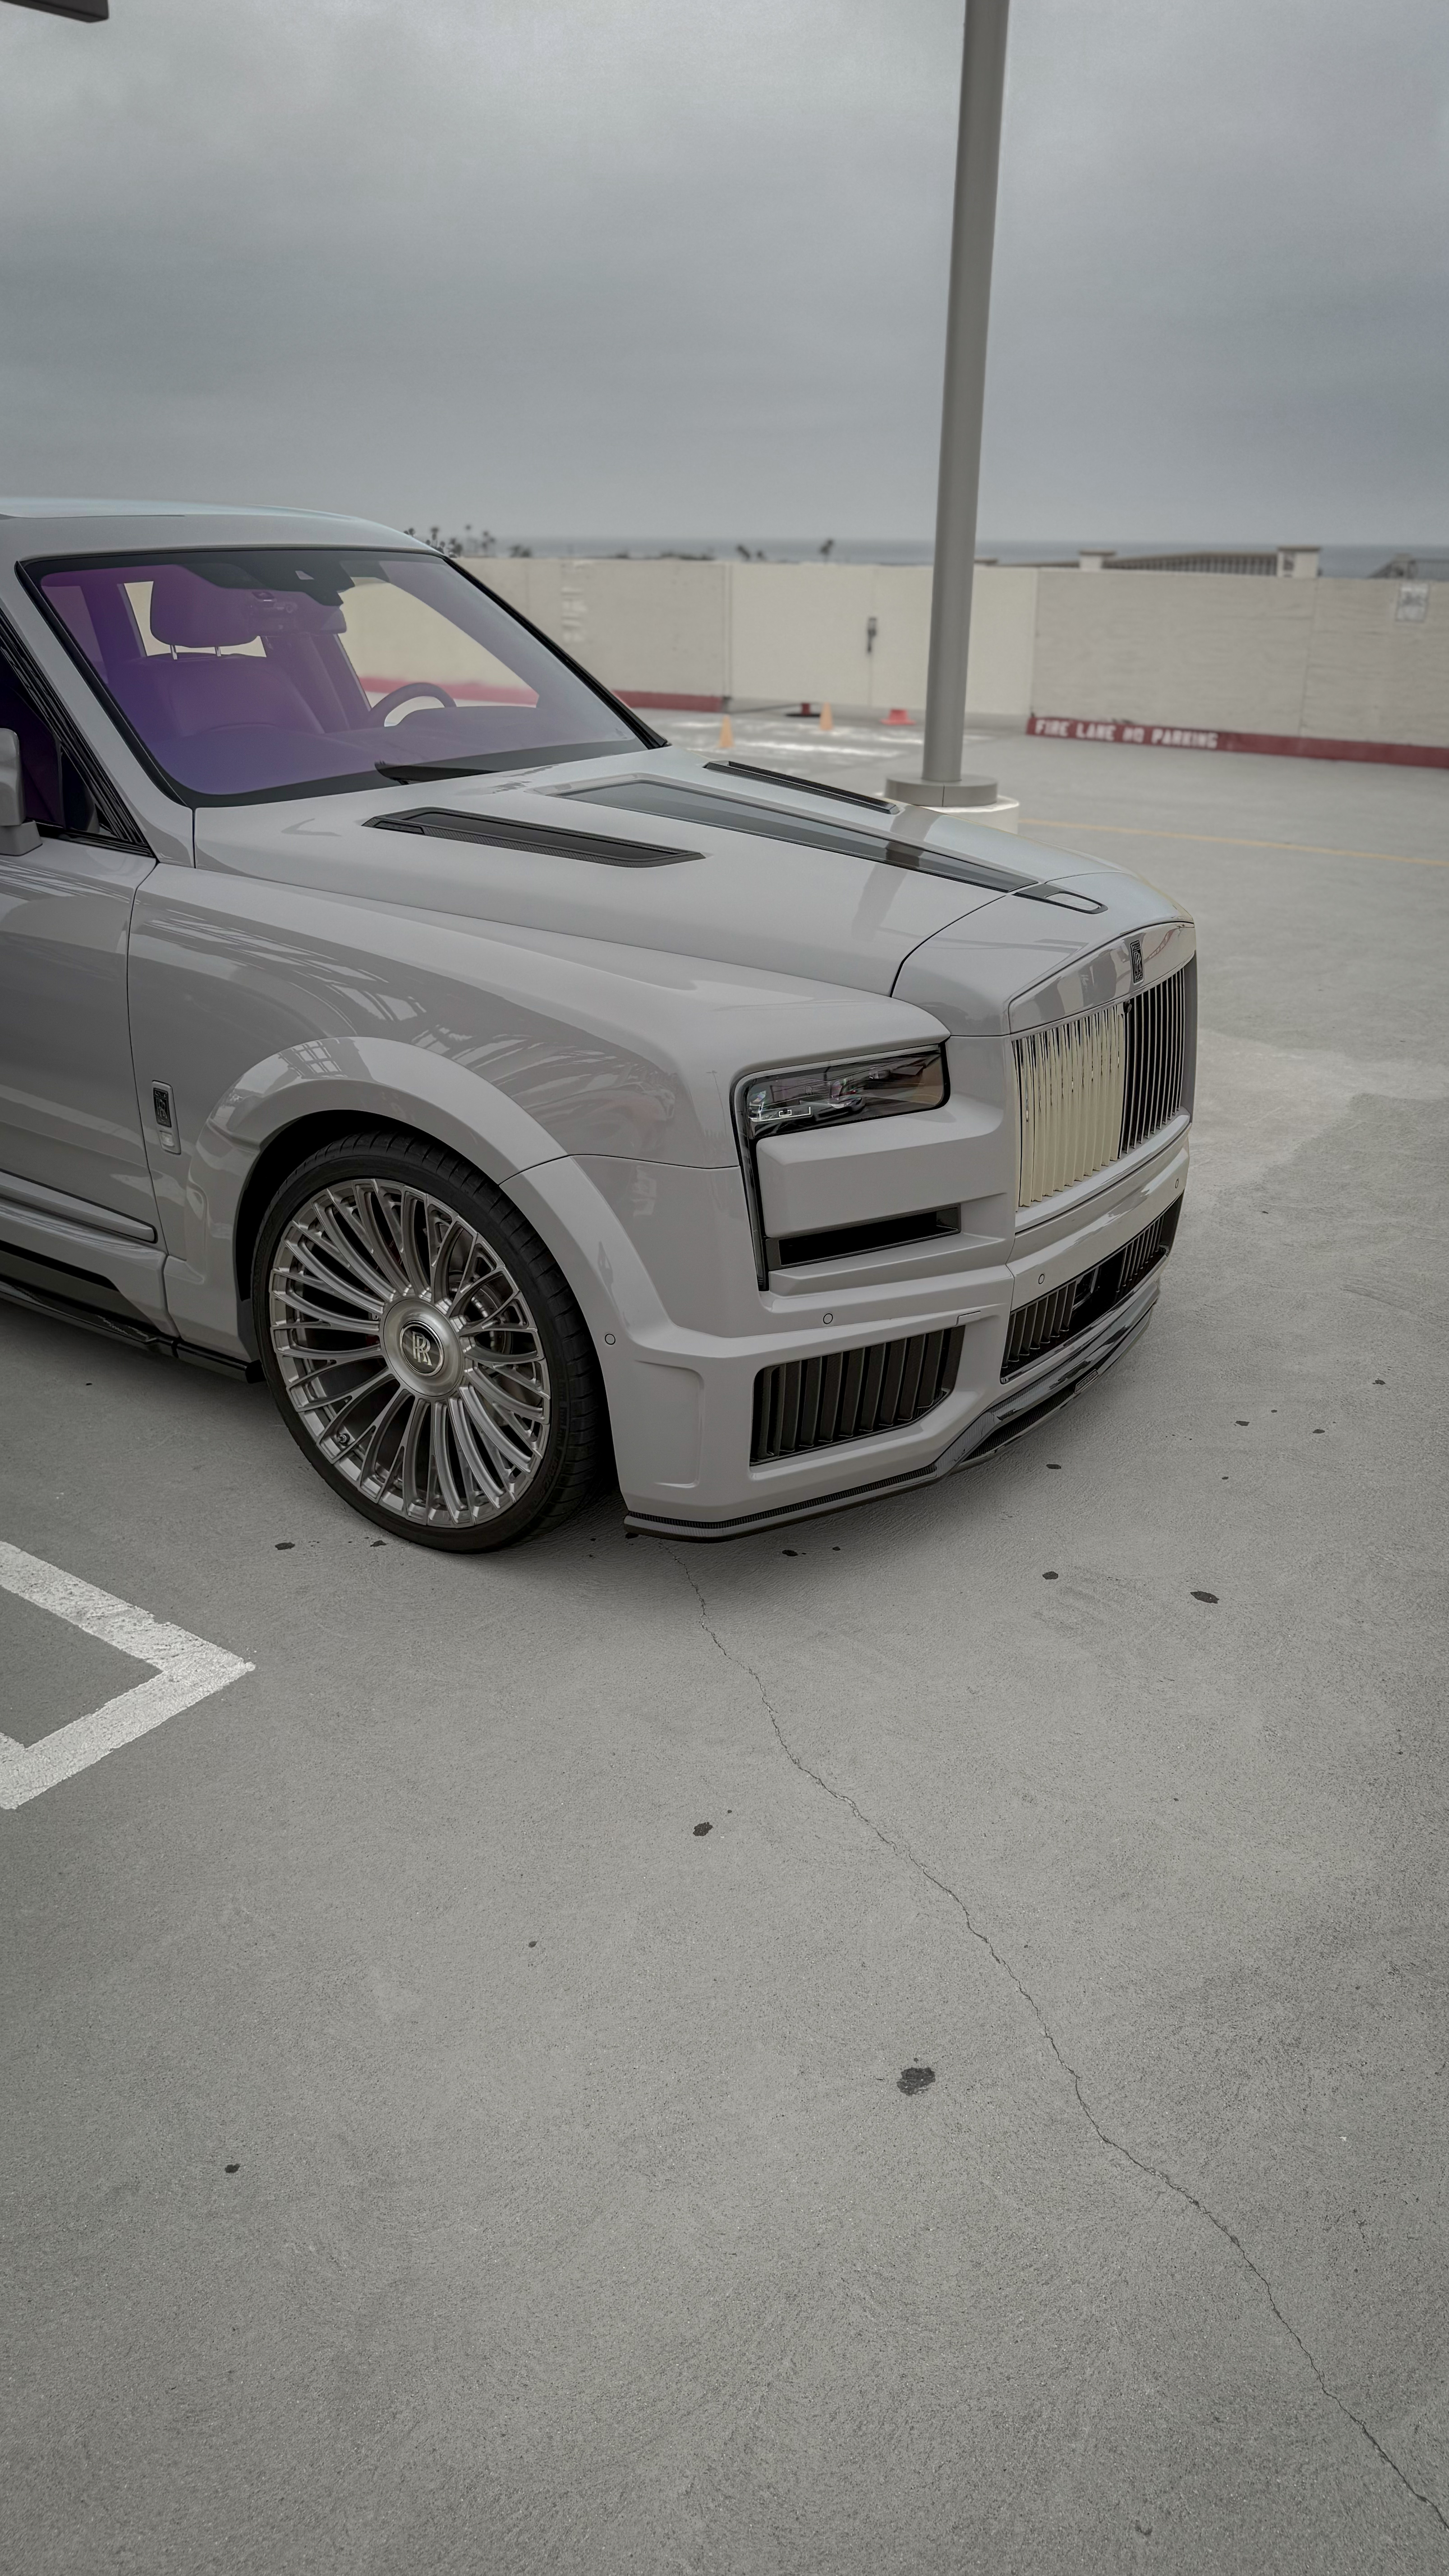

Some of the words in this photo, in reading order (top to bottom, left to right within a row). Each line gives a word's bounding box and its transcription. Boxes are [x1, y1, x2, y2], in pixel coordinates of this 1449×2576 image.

[1035, 719, 1069, 737] FIRE
[1076, 722, 1116, 741] LANE
[1122, 727, 1145, 743] NO
[1151, 728, 1218, 749] PARKING
[412, 1331, 432, 1366] RR
